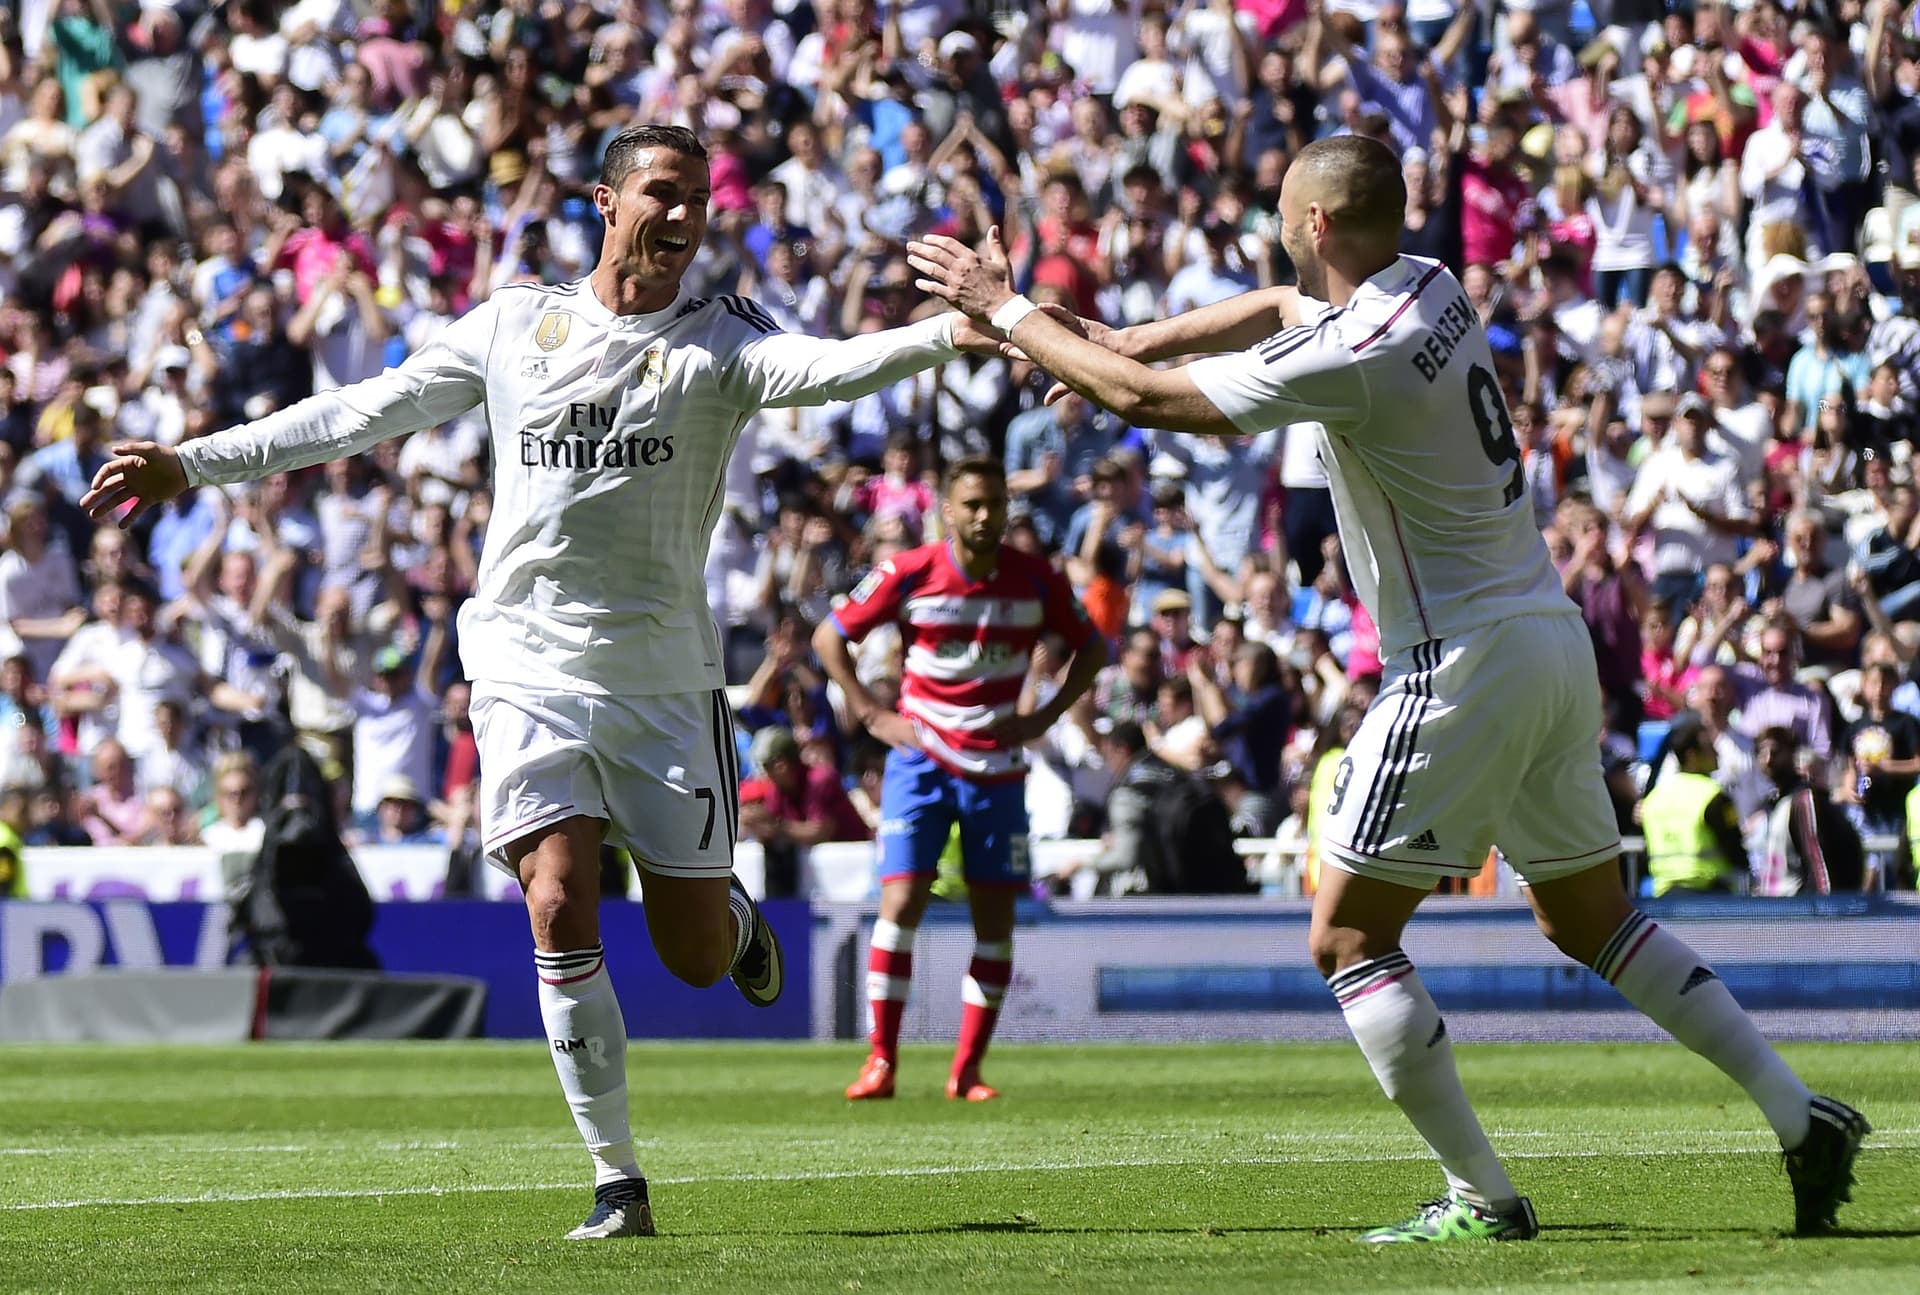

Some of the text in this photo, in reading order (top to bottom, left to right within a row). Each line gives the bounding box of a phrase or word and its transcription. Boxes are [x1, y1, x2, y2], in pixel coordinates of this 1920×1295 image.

[569, 402, 617, 432] Fly
[1467, 362, 1523, 507] 9
[520, 430, 675, 469] Emirates
[1327, 756, 1354, 815] 9
[694, 787, 716, 850] 7
[554, 1037, 587, 1052] RM
